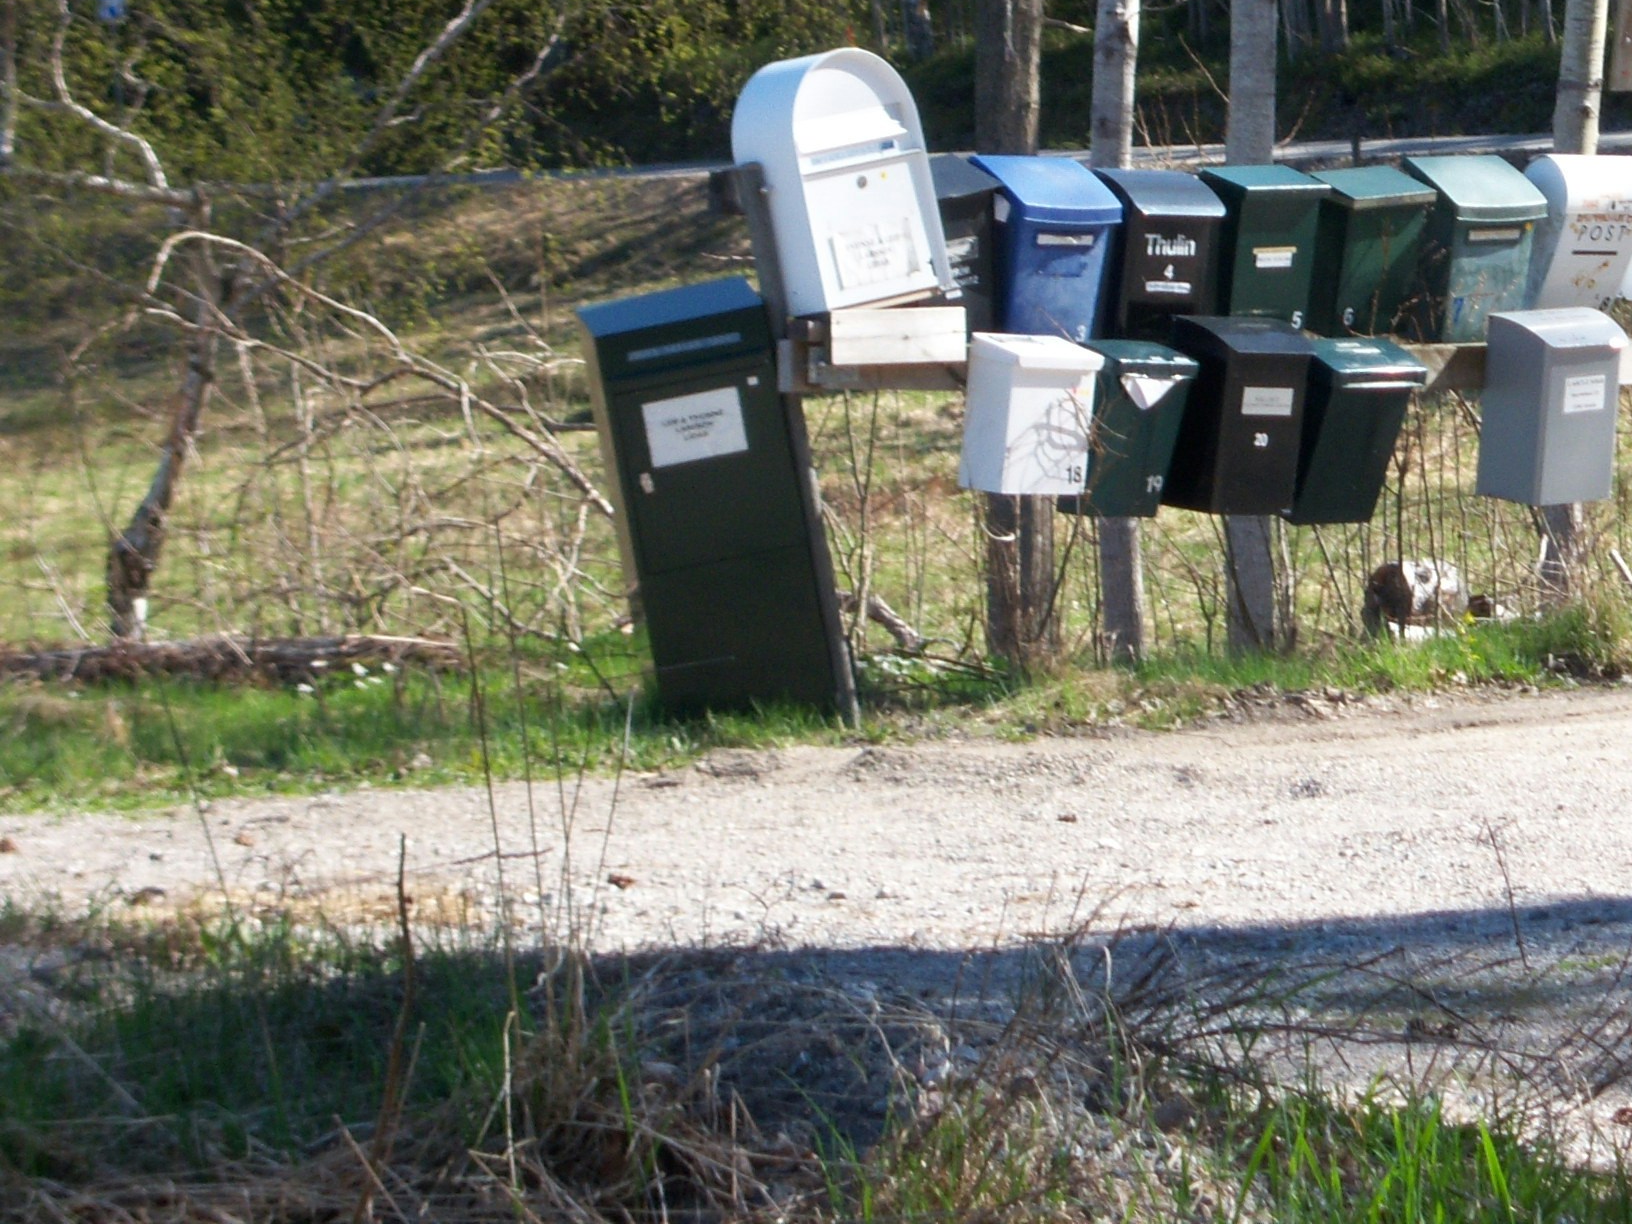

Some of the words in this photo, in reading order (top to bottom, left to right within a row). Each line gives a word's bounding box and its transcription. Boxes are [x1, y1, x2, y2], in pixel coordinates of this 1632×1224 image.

[1577, 225, 1627, 242] POST
[1144, 233, 1197, 256] Thulin
[1163, 263, 1173, 280] 4
[1291, 310, 1303, 329] 5
[1343, 306, 1354, 326] 6
[1075, 324, 1087, 343] 3
[1254, 432, 1269, 447] 20
[1066, 466, 1082, 484] 18
[1146, 474, 1163, 493] 19
